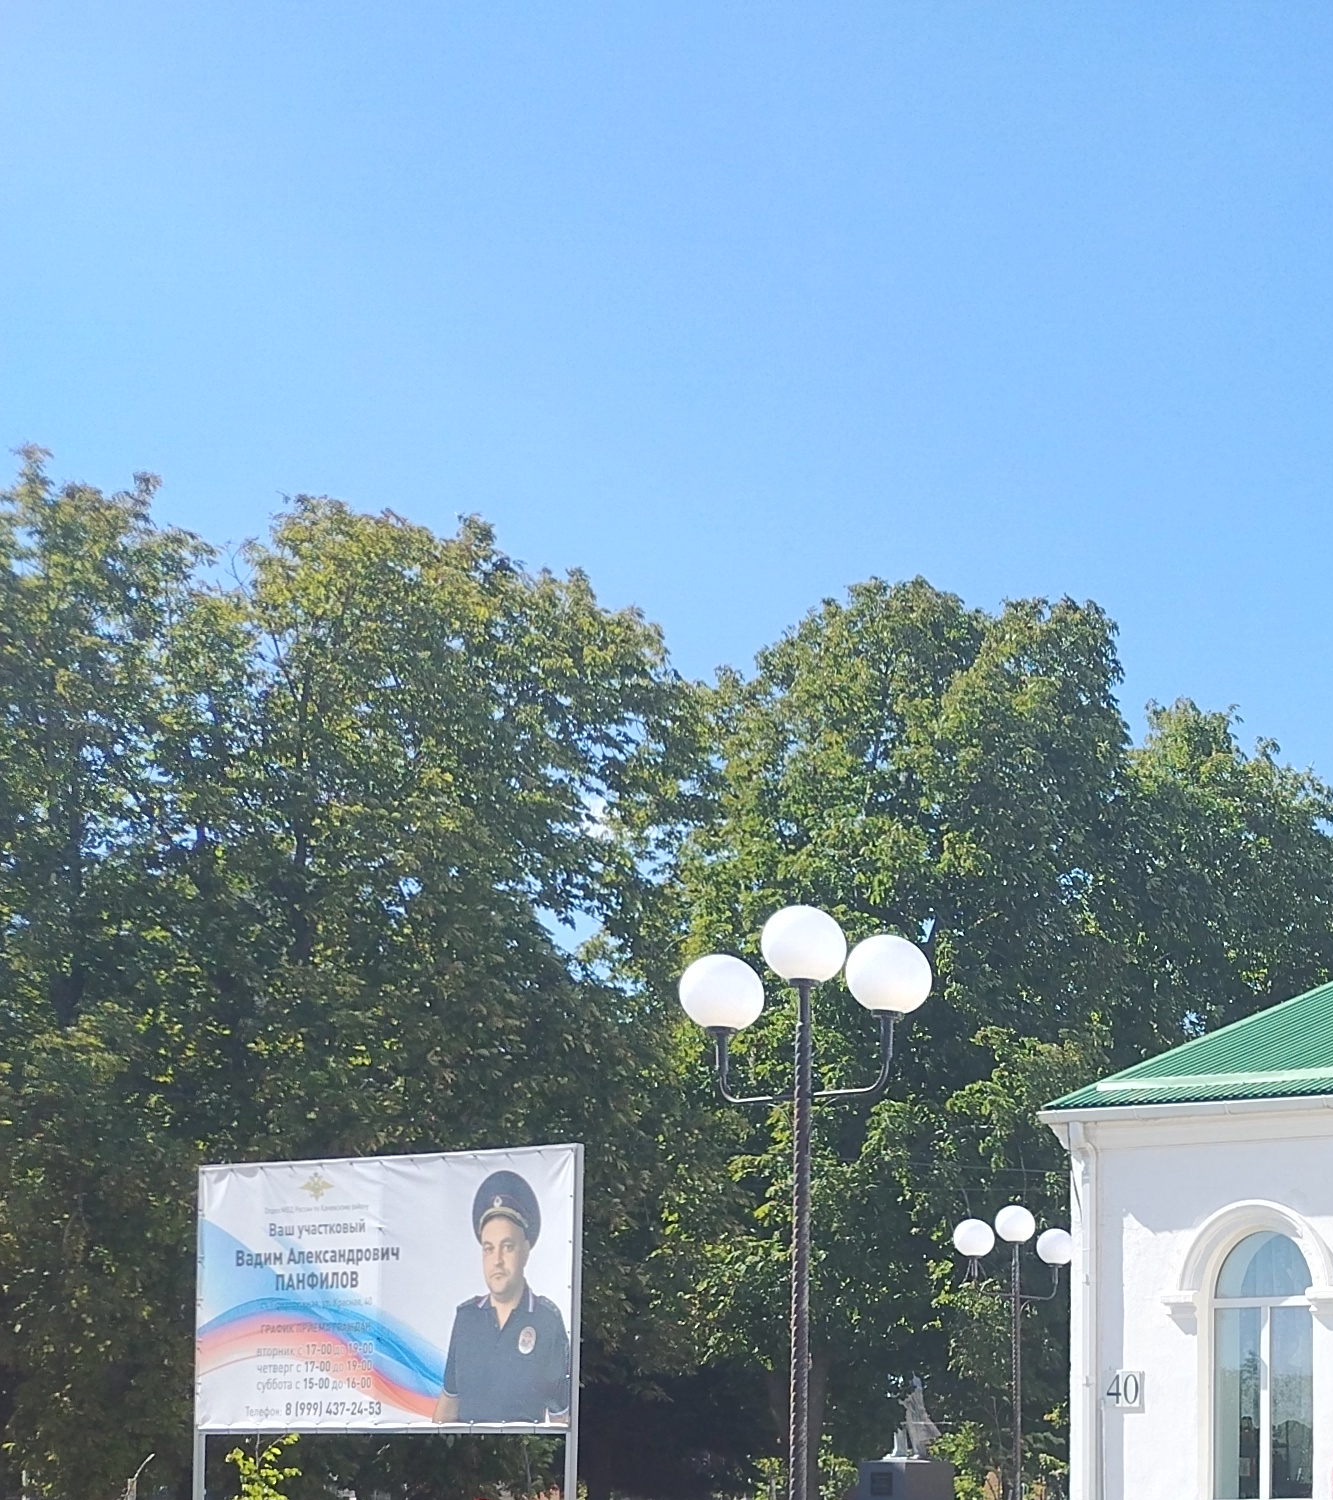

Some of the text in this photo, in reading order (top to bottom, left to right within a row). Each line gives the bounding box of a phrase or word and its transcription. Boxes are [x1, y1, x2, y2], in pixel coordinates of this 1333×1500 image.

[269, 1218, 366, 1239] Ваш участковый
[235, 1247, 400, 1268] Вадим Александрович
[275, 1271, 359, 1291] ПАНФИЛОВ
[306, 1343, 332, 1355] 17-00
[348, 1342, 374, 1354] 19-00
[257, 1362, 294, 1376] четверг
[304, 1360, 331, 1373] 17-00
[347, 1359, 373, 1371] 19-00
[256, 1378, 292, 1393] суббота
[303, 1377, 330, 1389] 15-00
[346, 1377, 372, 1388] 16-00
[1106, 1373, 1139, 1404] 40
[246, 1401, 382, 1418] Телефон: 8 (999) 437-24-53
